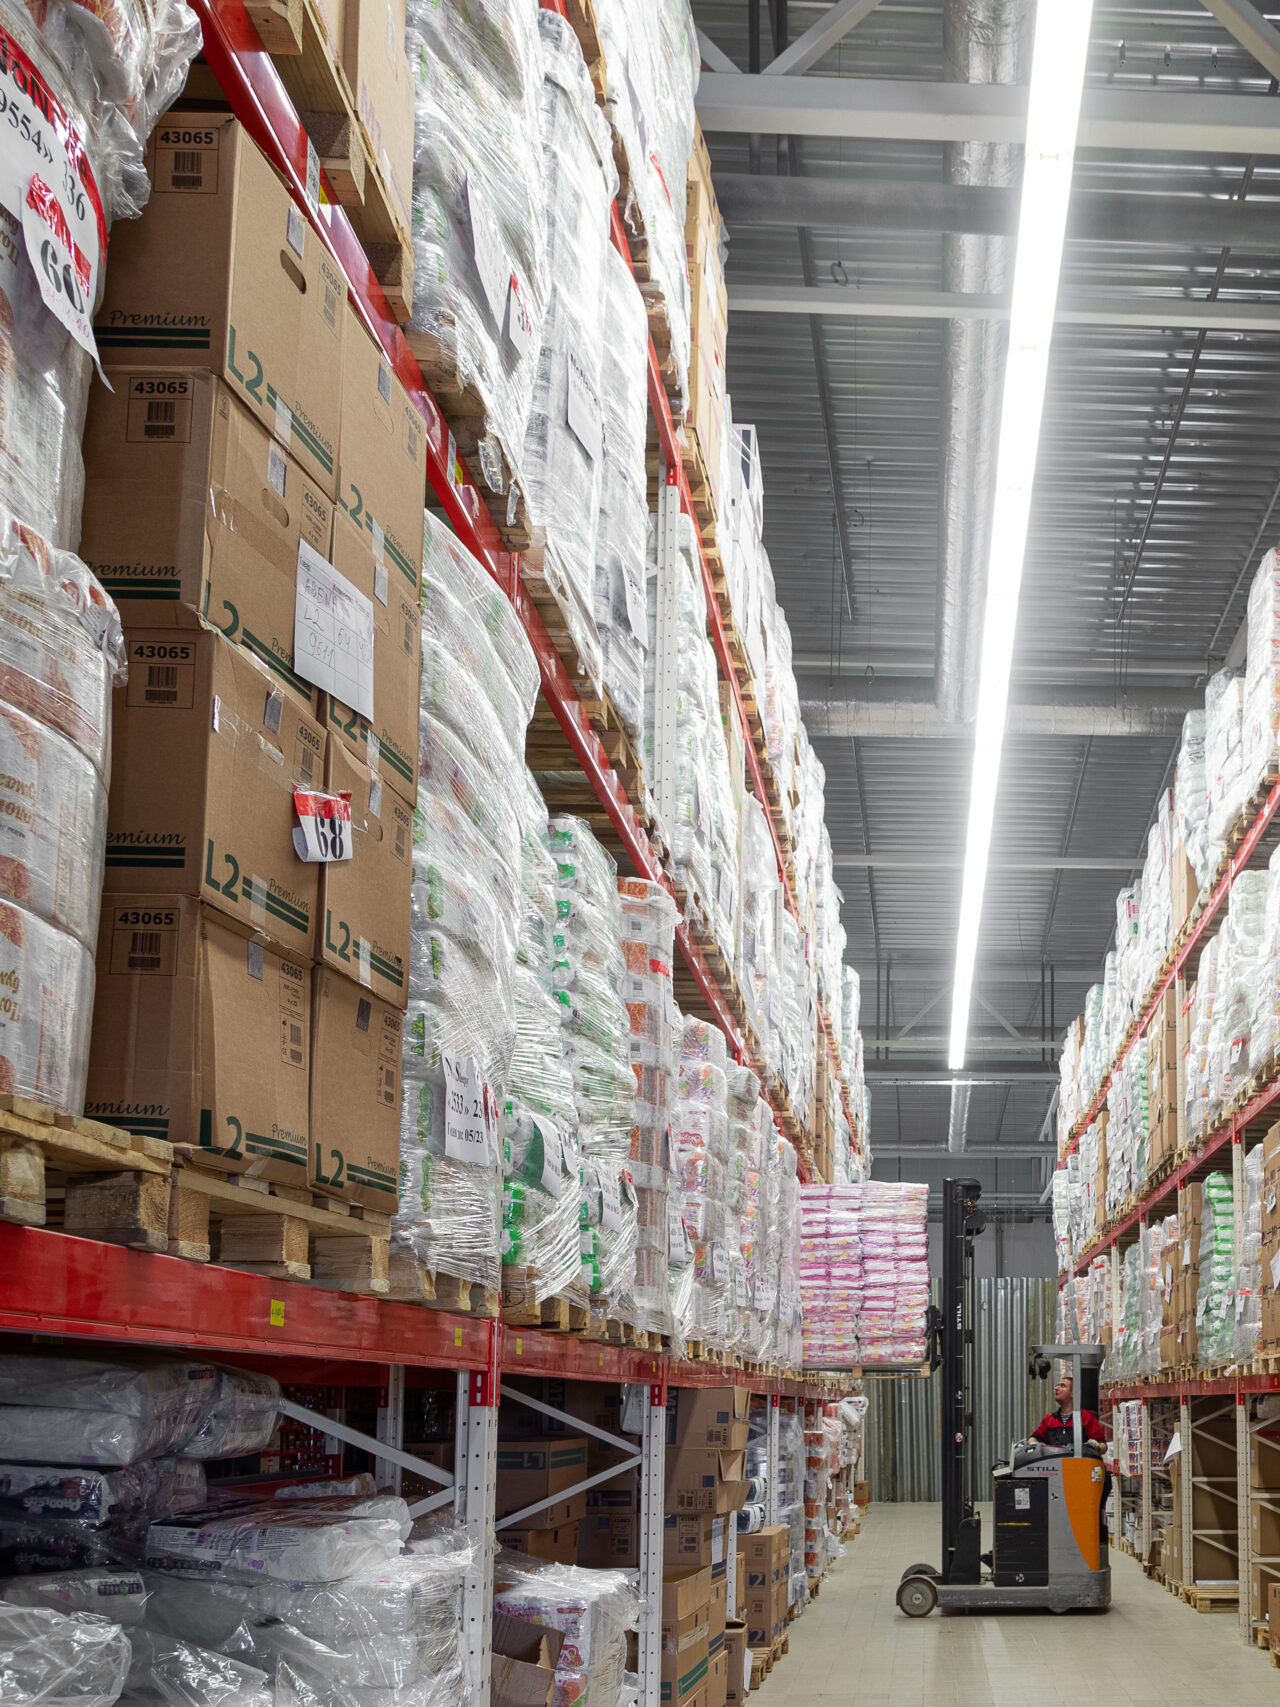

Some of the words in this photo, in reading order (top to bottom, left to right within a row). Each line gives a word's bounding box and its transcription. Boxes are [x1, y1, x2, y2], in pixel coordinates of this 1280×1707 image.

[160, 131, 214, 145] 43065
[62, 160, 86, 222] 336
[320, 262, 342, 296] 43065
[110, 310, 210, 327] Premium
[228, 325, 263, 407] L2
[134, 381, 188, 395] 43065
[294, 400, 335, 455] Premium
[303, 492, 327, 522] 43065
[386, 525, 418, 571] Premium
[134, 646, 191, 660] 43065
[271, 636, 301, 665] Prem
[298, 725, 321, 751] 43065
[381, 728, 415, 766] Premium
[104, 829, 186, 845] emium
[315, 811, 345, 860] 68
[205, 839, 239, 903] L2
[269, 878, 310, 913] Premium
[118, 911, 175, 926] 43065
[326, 908, 350, 962] L2
[281, 960, 304, 982] 43065
[384, 1013, 401, 1032] 43065
[85, 1101, 170, 1117] emium
[200, 1109, 243, 1162] L2
[271, 1123, 307, 1146] Premium
[464, 1128, 484, 1144] 05/23
[315, 1142, 344, 1189] L2
[367, 1156, 396, 1176] Premium
